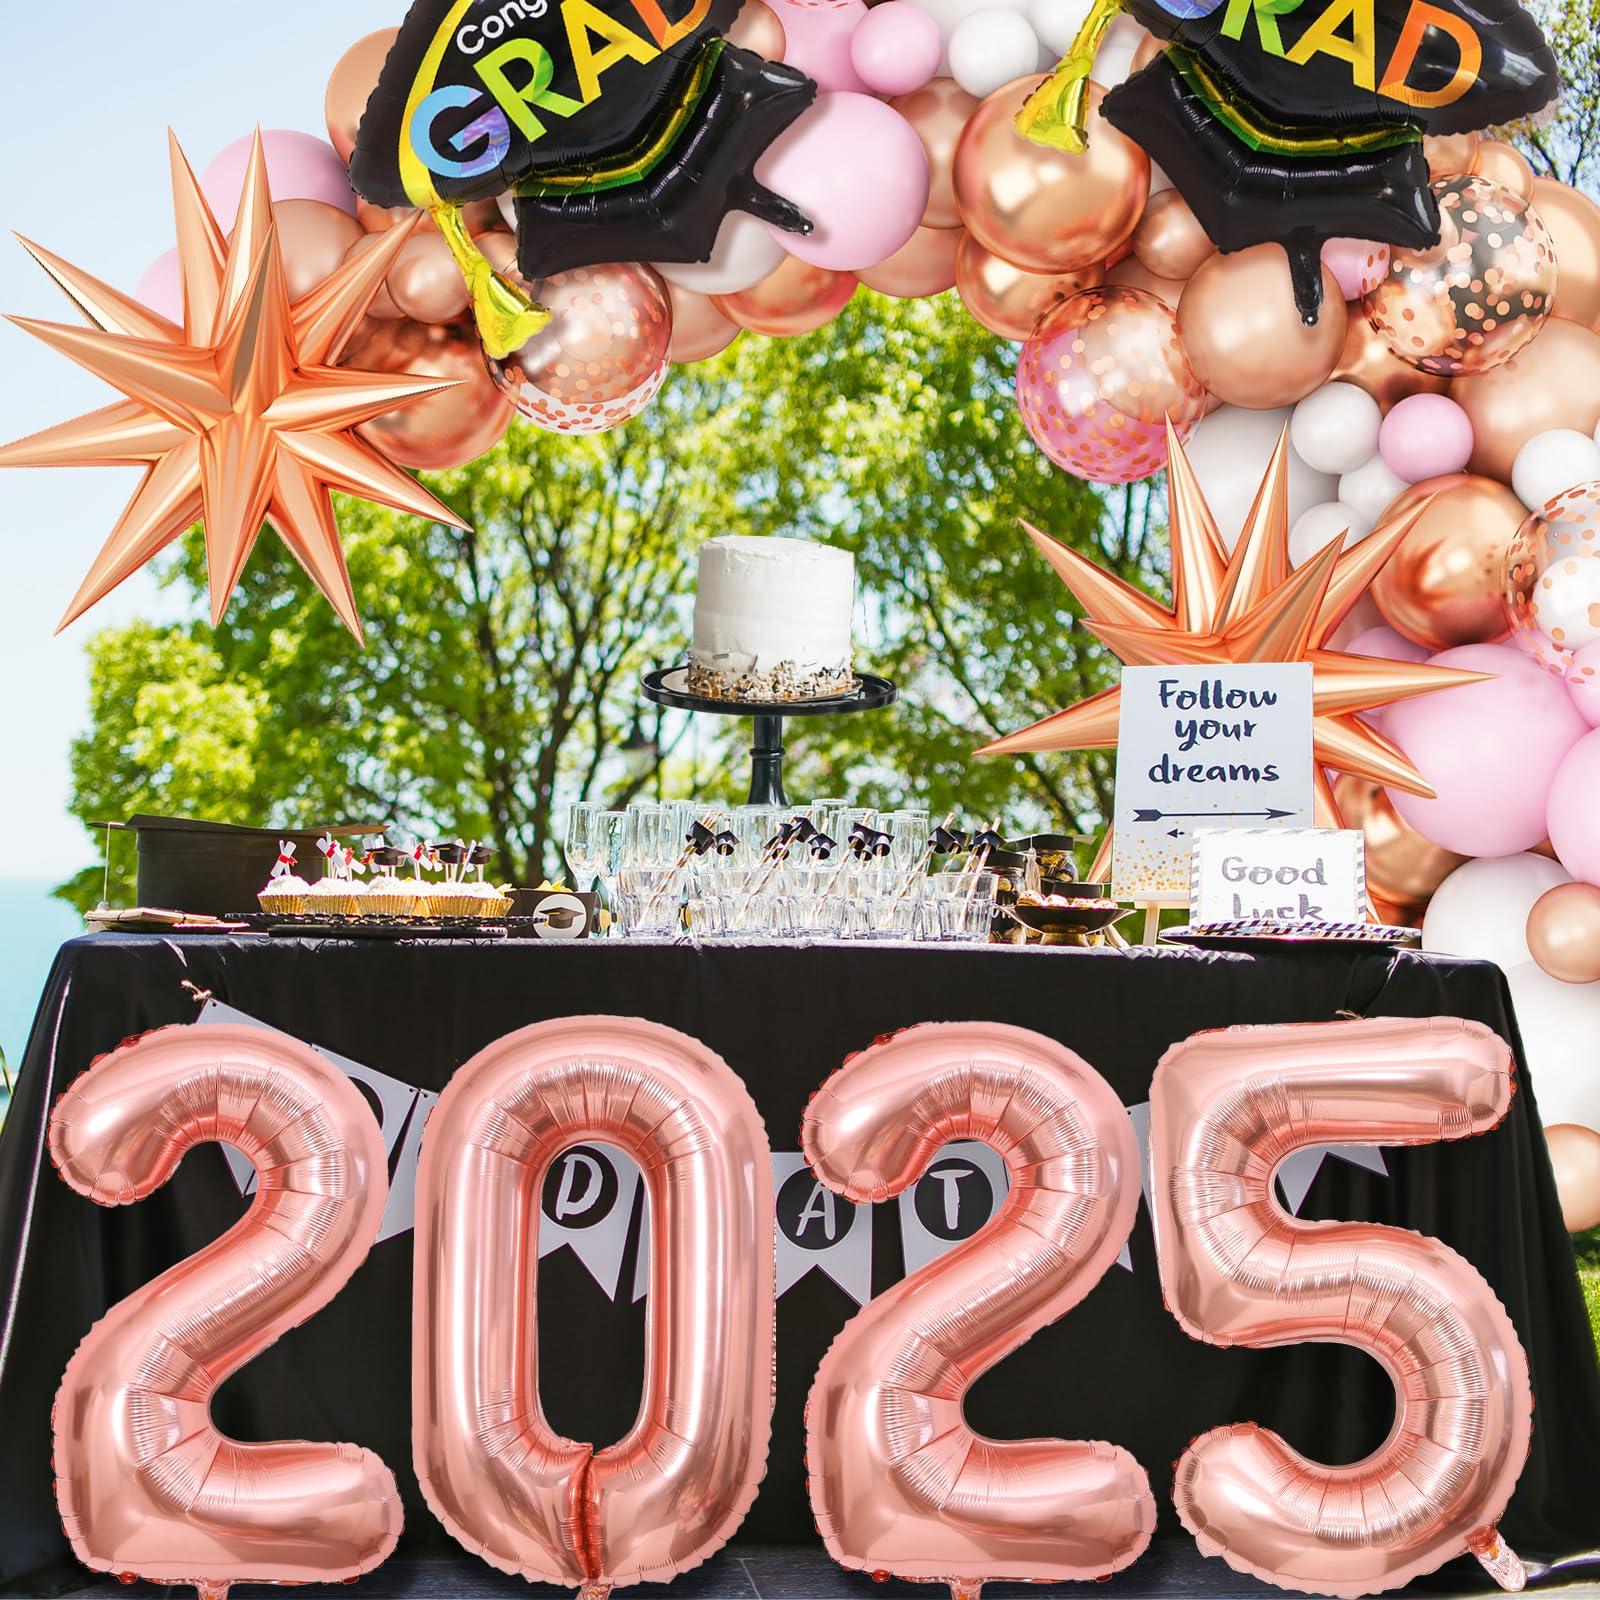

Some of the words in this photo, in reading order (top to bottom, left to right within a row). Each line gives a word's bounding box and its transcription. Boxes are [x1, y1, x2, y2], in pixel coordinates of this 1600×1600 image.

[1154, 0, 1483, 109] RAD
[1158, 679, 1278, 710] Follow
[1174, 719, 1257, 751] your
[1148, 753, 1280, 784] dreams
[1221, 856, 1328, 885] Good
[1232, 893, 1325, 920] Luck
[49, 1015, 1534, 1598] 2025
